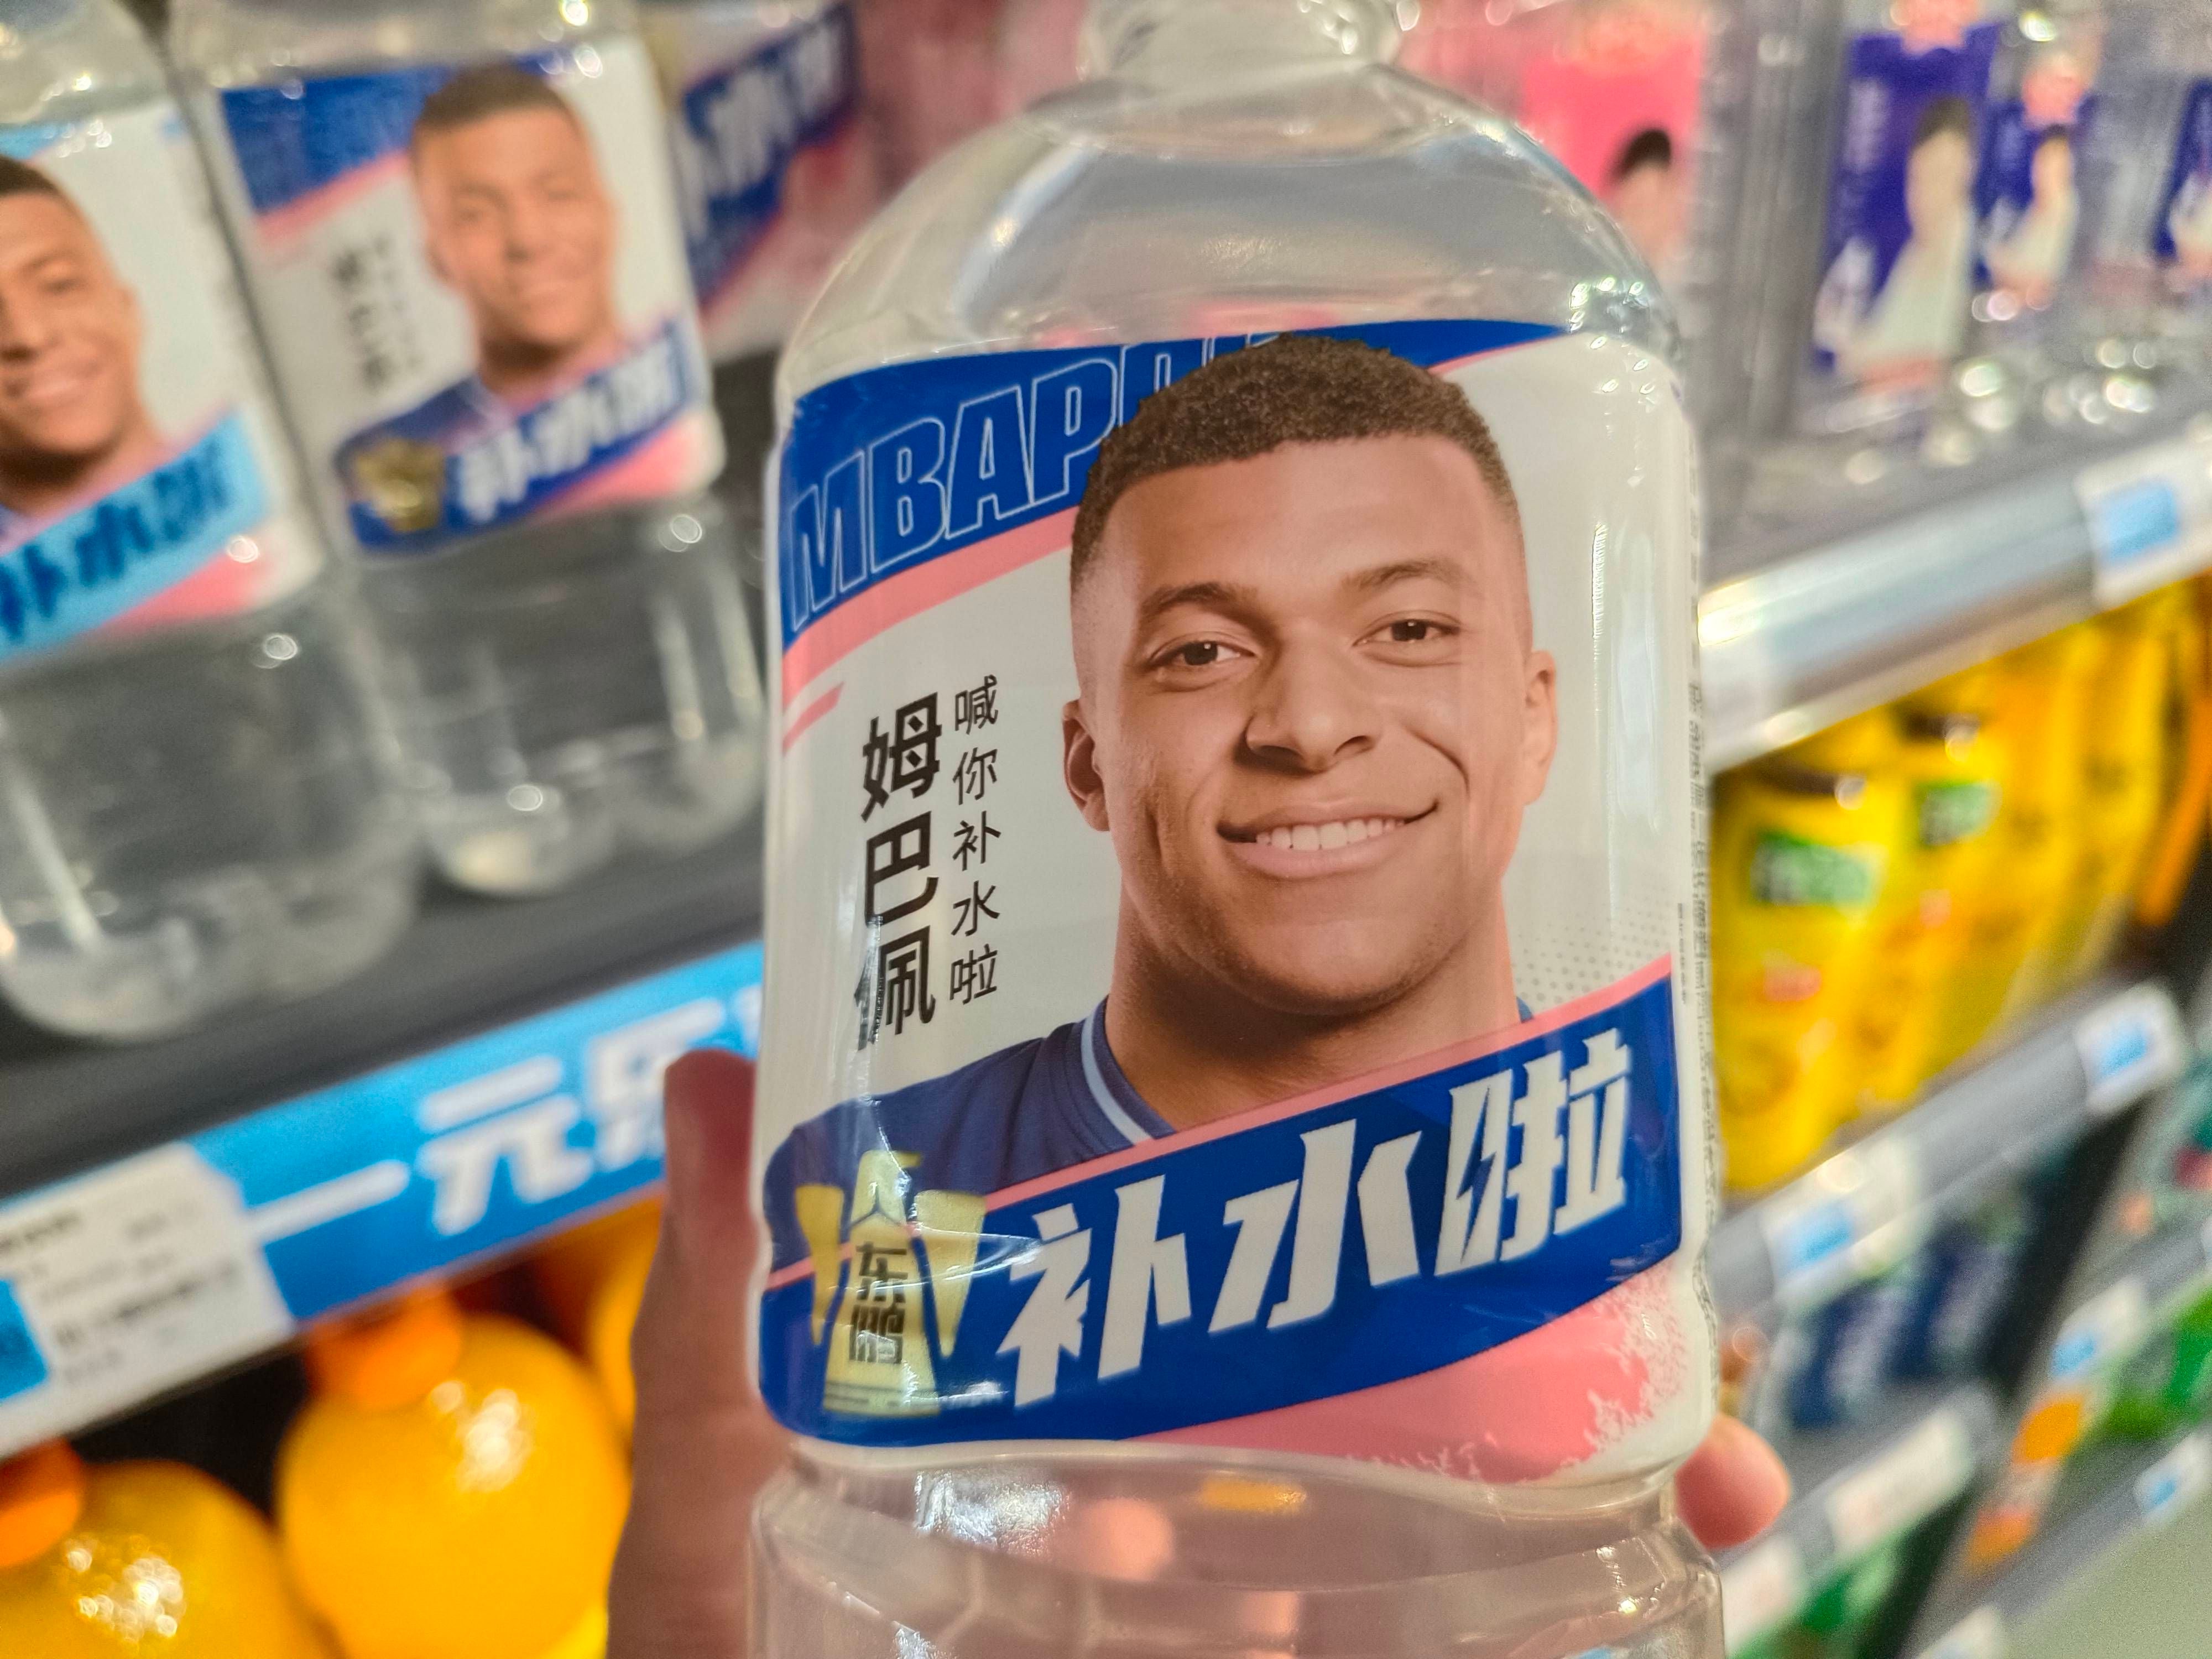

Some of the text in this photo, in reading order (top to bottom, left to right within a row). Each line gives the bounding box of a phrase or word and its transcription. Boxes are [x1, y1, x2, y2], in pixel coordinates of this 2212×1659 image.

[792, 333, 1277, 632] MBAP
[854, 692, 942, 1051] 姆巴佩
[948, 675, 1001, 1005] 喊你补水啦
[849, 1241, 908, 1364] 东鹏
[996, 1028, 1631, 1410] 补水啦
